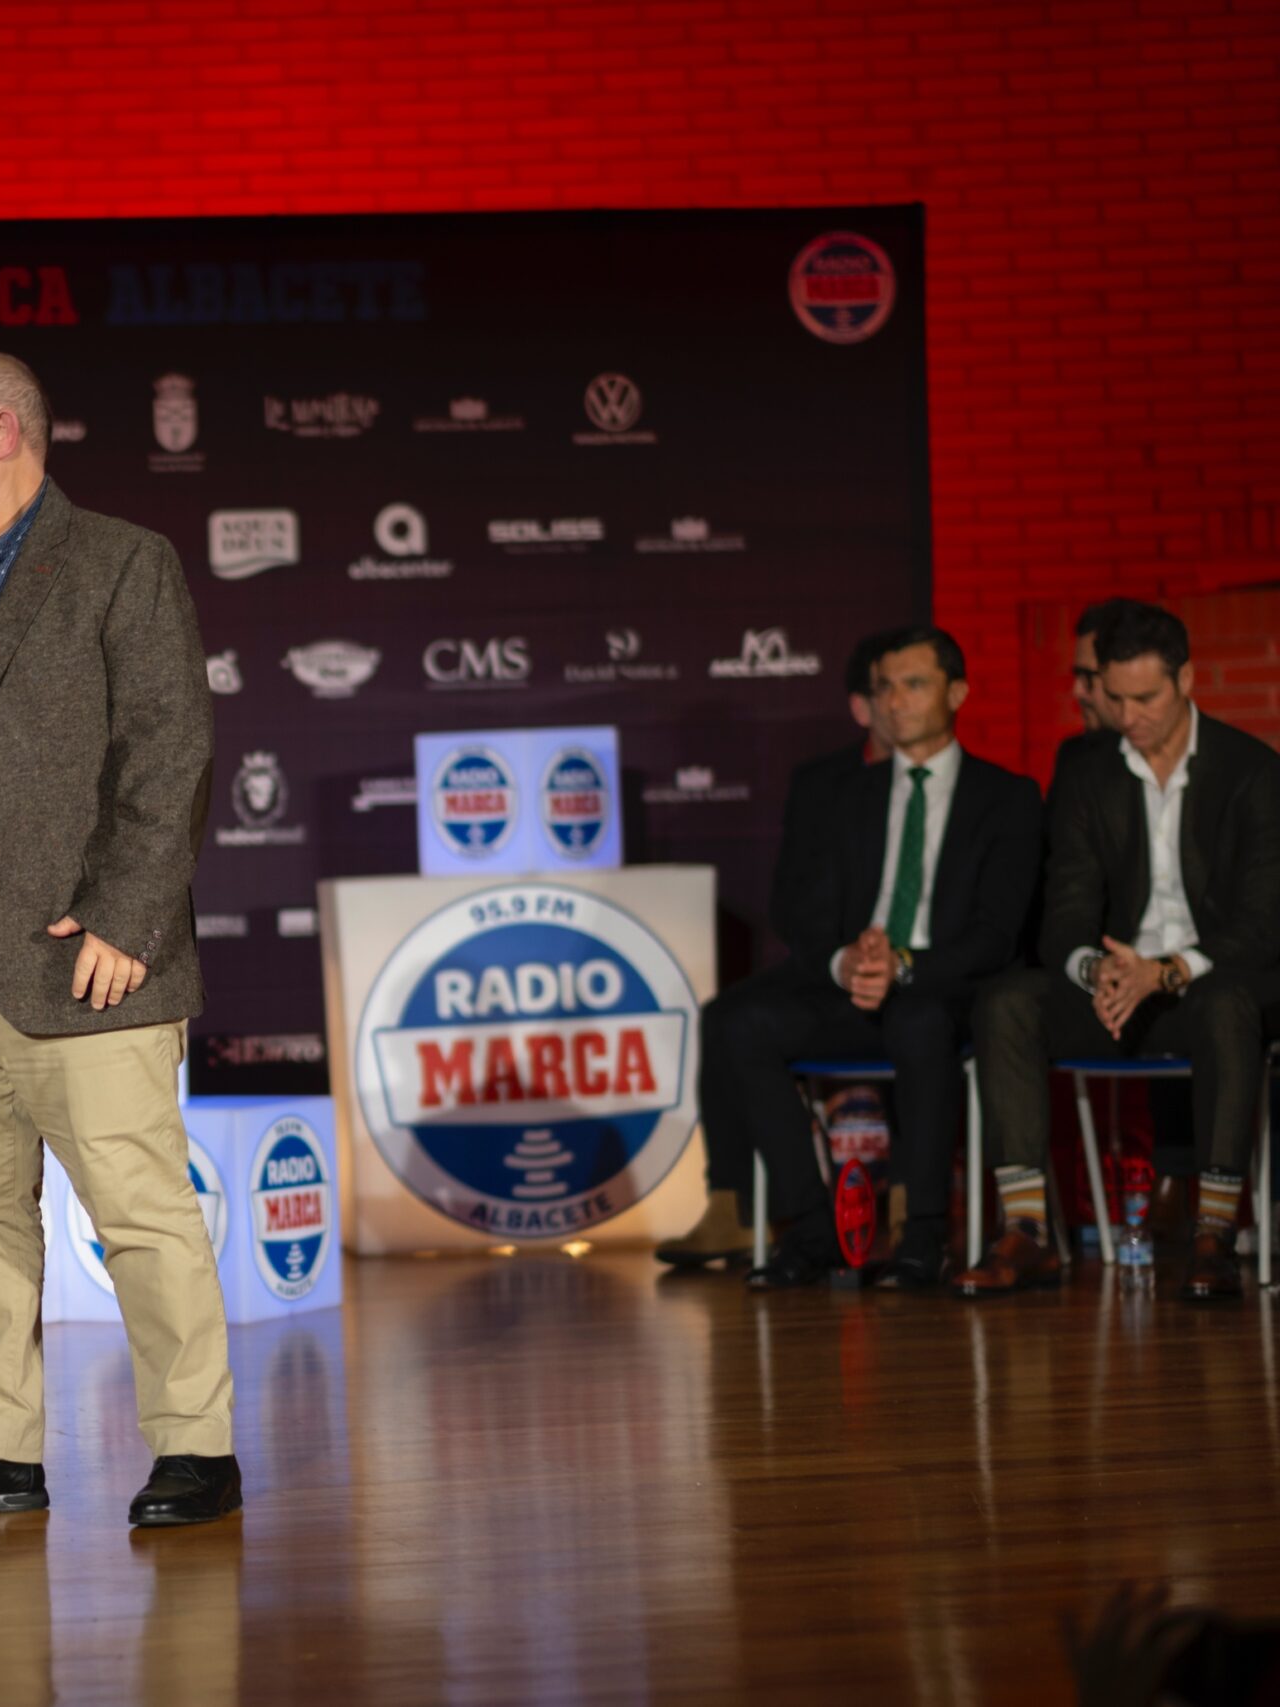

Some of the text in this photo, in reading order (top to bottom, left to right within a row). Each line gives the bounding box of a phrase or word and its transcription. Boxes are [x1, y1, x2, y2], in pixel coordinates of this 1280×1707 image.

[105, 260, 426, 325] ALBACETE
[422, 637, 534, 683] CMS
[470, 895, 575, 924] 95.9 FM
[434, 958, 624, 1020] RADIO
[416, 1028, 657, 1108] MARCA
[267, 1155, 316, 1185] RADIO
[264, 1190, 324, 1233] MARCA
[469, 1191, 614, 1231] ALBACETE
